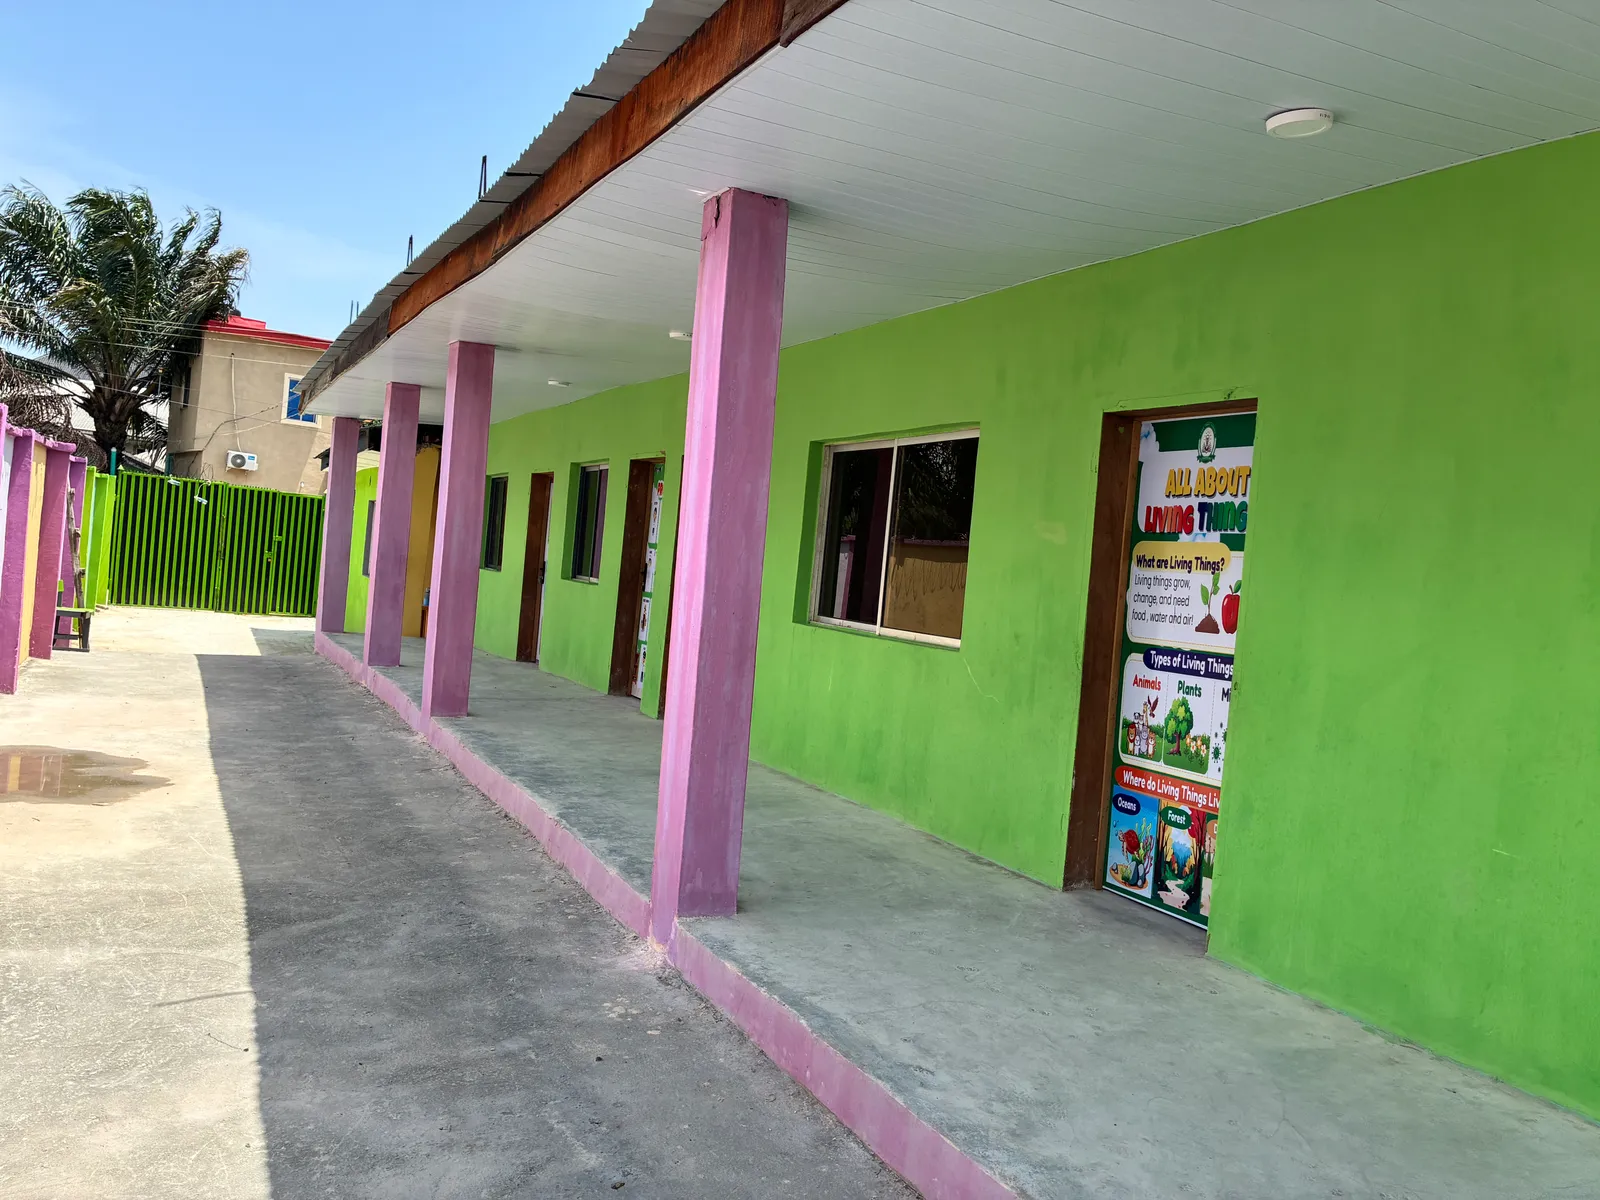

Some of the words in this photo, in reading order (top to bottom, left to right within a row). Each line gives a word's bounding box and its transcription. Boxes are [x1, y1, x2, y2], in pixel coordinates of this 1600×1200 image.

[1165, 468, 1192, 498] ALL
[1194, 466, 1251, 498] ABOUT
[1144, 505, 1195, 535] LIVING
[1136, 554, 1155, 569] What
[1156, 558, 1168, 569] are
[1170, 555, 1192, 574] Living
[1195, 556, 1225, 575] Things?
[1134, 574, 1152, 589] Living
[1153, 575, 1172, 591] things
[1173, 578, 1191, 590] grow,
[1133, 593, 1157, 607] change,
[1159, 594, 1172, 606] and
[1173, 595, 1190, 607] need
[1150, 612, 1168, 623] water
[1169, 613, 1182, 625] and
[1183, 614, 1194, 625] air!
[1150, 650, 1171, 668] Types
[1172, 654, 1181, 667] of
[1182, 655, 1205, 675] Living
[1207, 657, 1233, 679] Things
[1133, 674, 1161, 691] Animals
[1177, 680, 1202, 698] Plants
[1123, 770, 1146, 789] Where
[1147, 778, 1156, 791] do
[1157, 780, 1180, 800] Living
[1181, 785, 1207, 808] Things
[1117, 797, 1137, 811] Oceans
[1167, 811, 1186, 825] Forest
